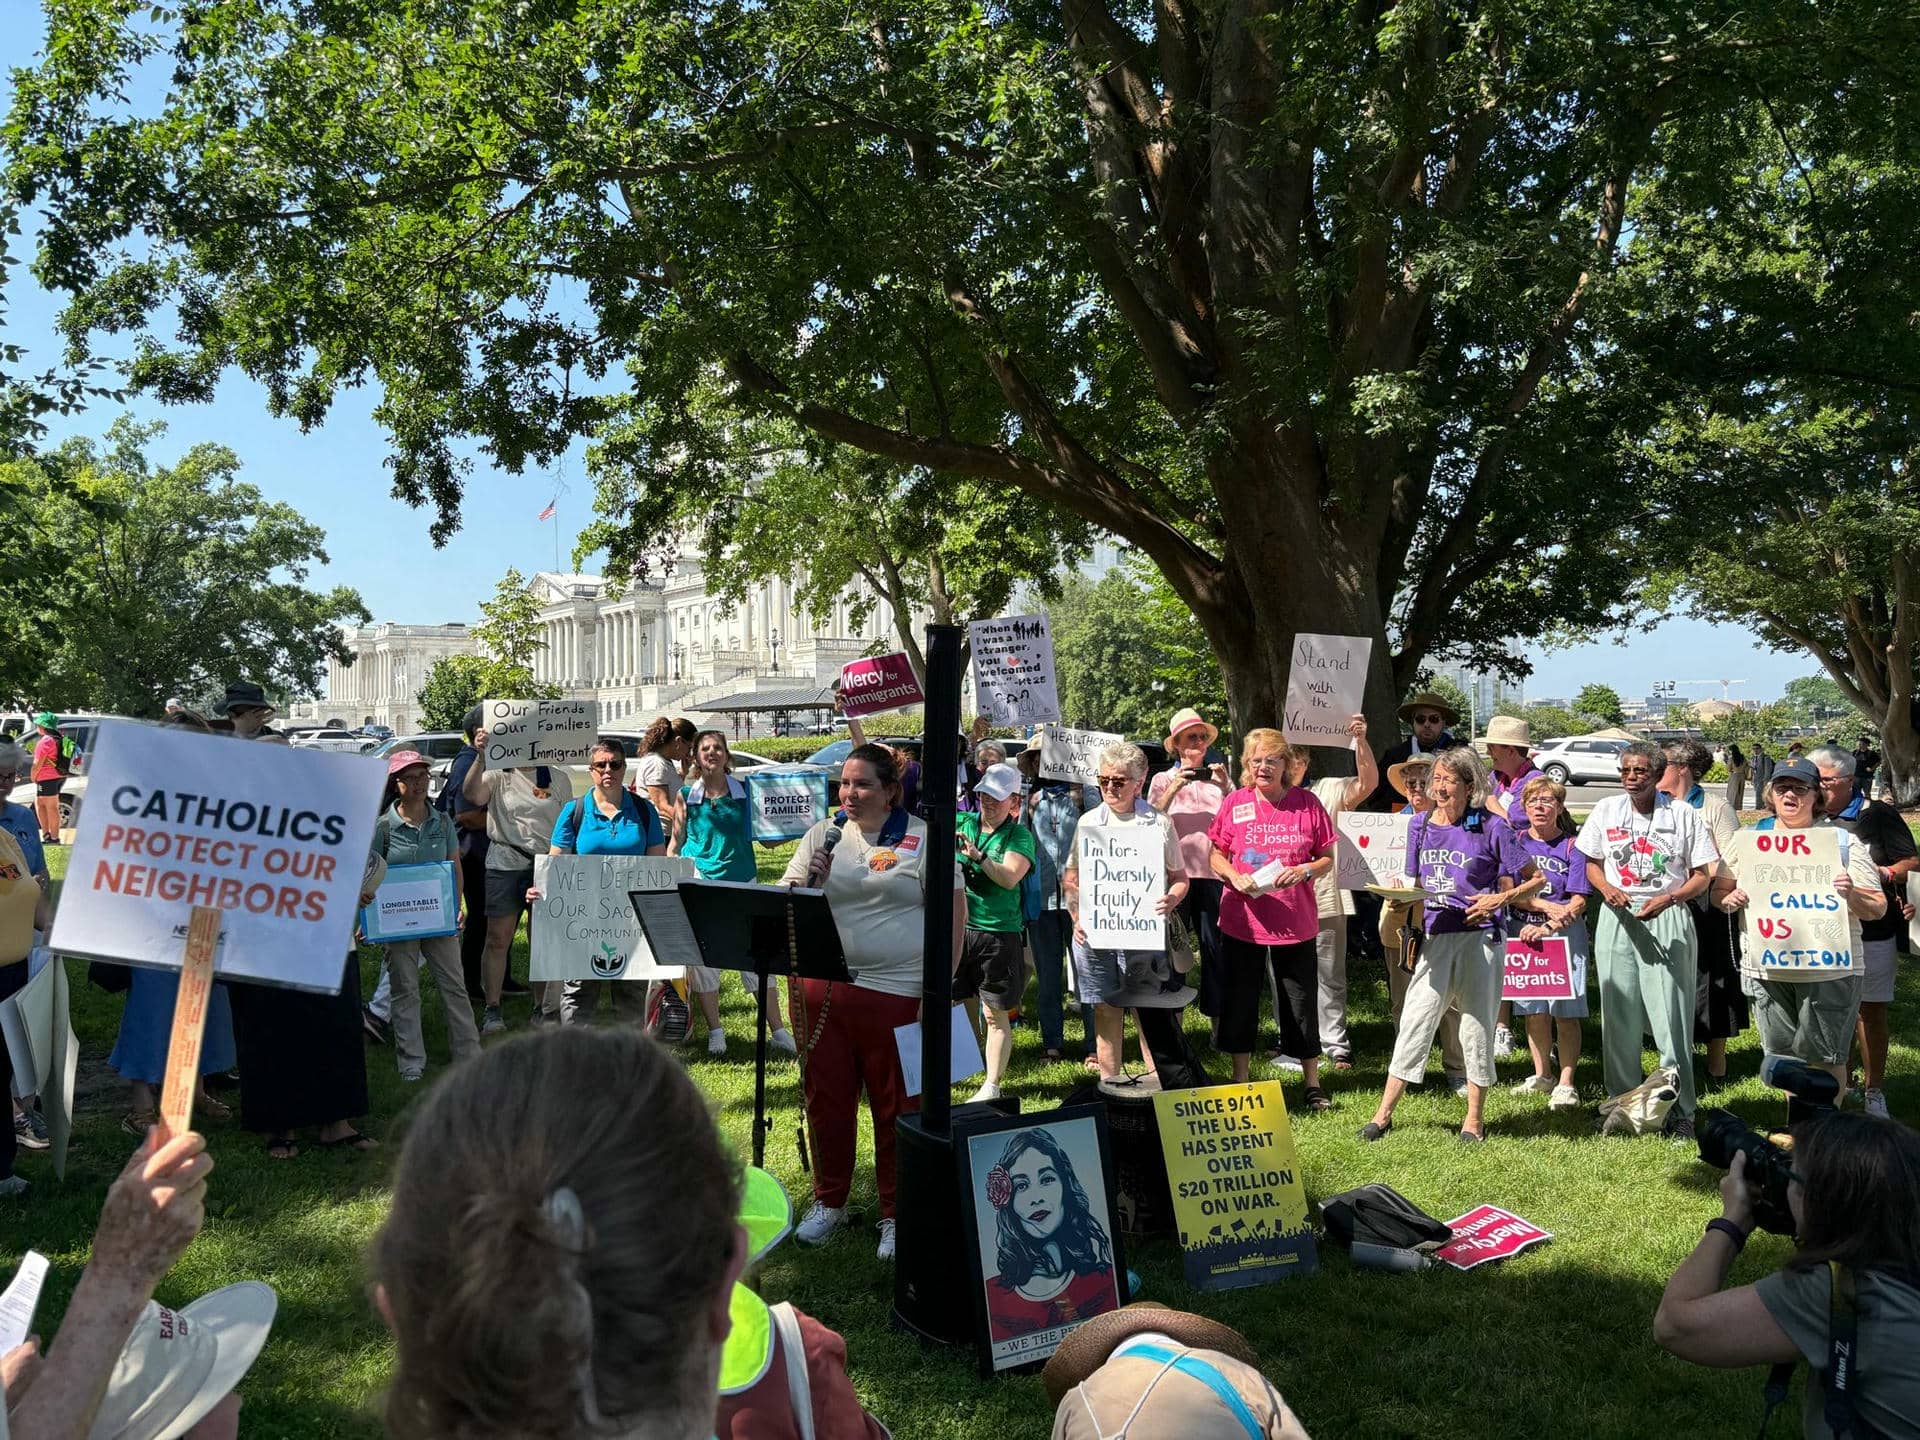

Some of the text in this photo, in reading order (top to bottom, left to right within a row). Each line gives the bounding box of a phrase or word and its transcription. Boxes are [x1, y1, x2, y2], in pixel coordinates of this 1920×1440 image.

[977, 644, 1030, 655] stranger,
[1295, 640, 1350, 671] Stand
[978, 657, 1000, 668] you
[980, 662, 1041, 677] welcomed
[842, 669, 899, 690] Mercy for
[1306, 680, 1337, 693] with
[493, 701, 585, 718] Our Friends
[1311, 696, 1332, 708] the
[492, 717, 591, 736] Our Families
[1285, 710, 1351, 736] Vulnerable
[1051, 730, 1111, 748] HEALTHCAR
[489, 740, 591, 762] Our Immigrant
[1070, 752, 1089, 761] NOT
[1043, 762, 1099, 777] WEALTHCA
[764, 795, 811, 805] PROTECT
[764, 805, 810, 815] FAMILIES
[111, 785, 346, 846] CATHOLICS
[1347, 814, 1394, 828] GODS
[1246, 822, 1298, 834] Sisters of
[1083, 837, 1103, 857] I'm
[1261, 833, 1304, 846] Joseph
[1389, 835, 1406, 847] IS
[1757, 834, 1811, 855] OUR
[102, 823, 258, 870] PROTECT
[263, 848, 337, 882] OUR
[1418, 849, 1472, 868] MERCY
[1339, 856, 1402, 872] UNCONDI
[1532, 855, 1569, 876] RCY
[1754, 863, 1832, 884] FAITH
[555, 861, 672, 891] WE DEFEND
[93, 859, 328, 922] NEIGHBORS
[382, 898, 439, 910] LONGER TABLES
[548, 896, 633, 919] OUR SAC
[1770, 892, 1839, 911] CALLS
[566, 920, 644, 941] COMMUNIT
[1757, 917, 1842, 940] US TO
[1504, 952, 1549, 969] rcy for
[1761, 949, 1851, 967] ACTION
[1503, 971, 1566, 990] migrants
[1174, 1094, 1265, 1117] SINCE 9/11
[1187, 1115, 1257, 1136] THE U.S.
[1181, 1132, 1273, 1157] HAS SPENT
[1207, 1154, 1255, 1174] OVER
[1178, 1169, 1294, 1199] $20 TRILLION
[1201, 1192, 1280, 1216] ON WAR.
[1453, 1211, 1510, 1238] Immig
[1468, 1222, 1535, 1250] Mercy
[1453, 1242, 1473, 1252] for
[160, 1307, 173, 1339] EAR
[1007, 1338, 1030, 1352] WE
[1032, 1330, 1057, 1345] THE
[1835, 1357, 1846, 1390] Nikon
